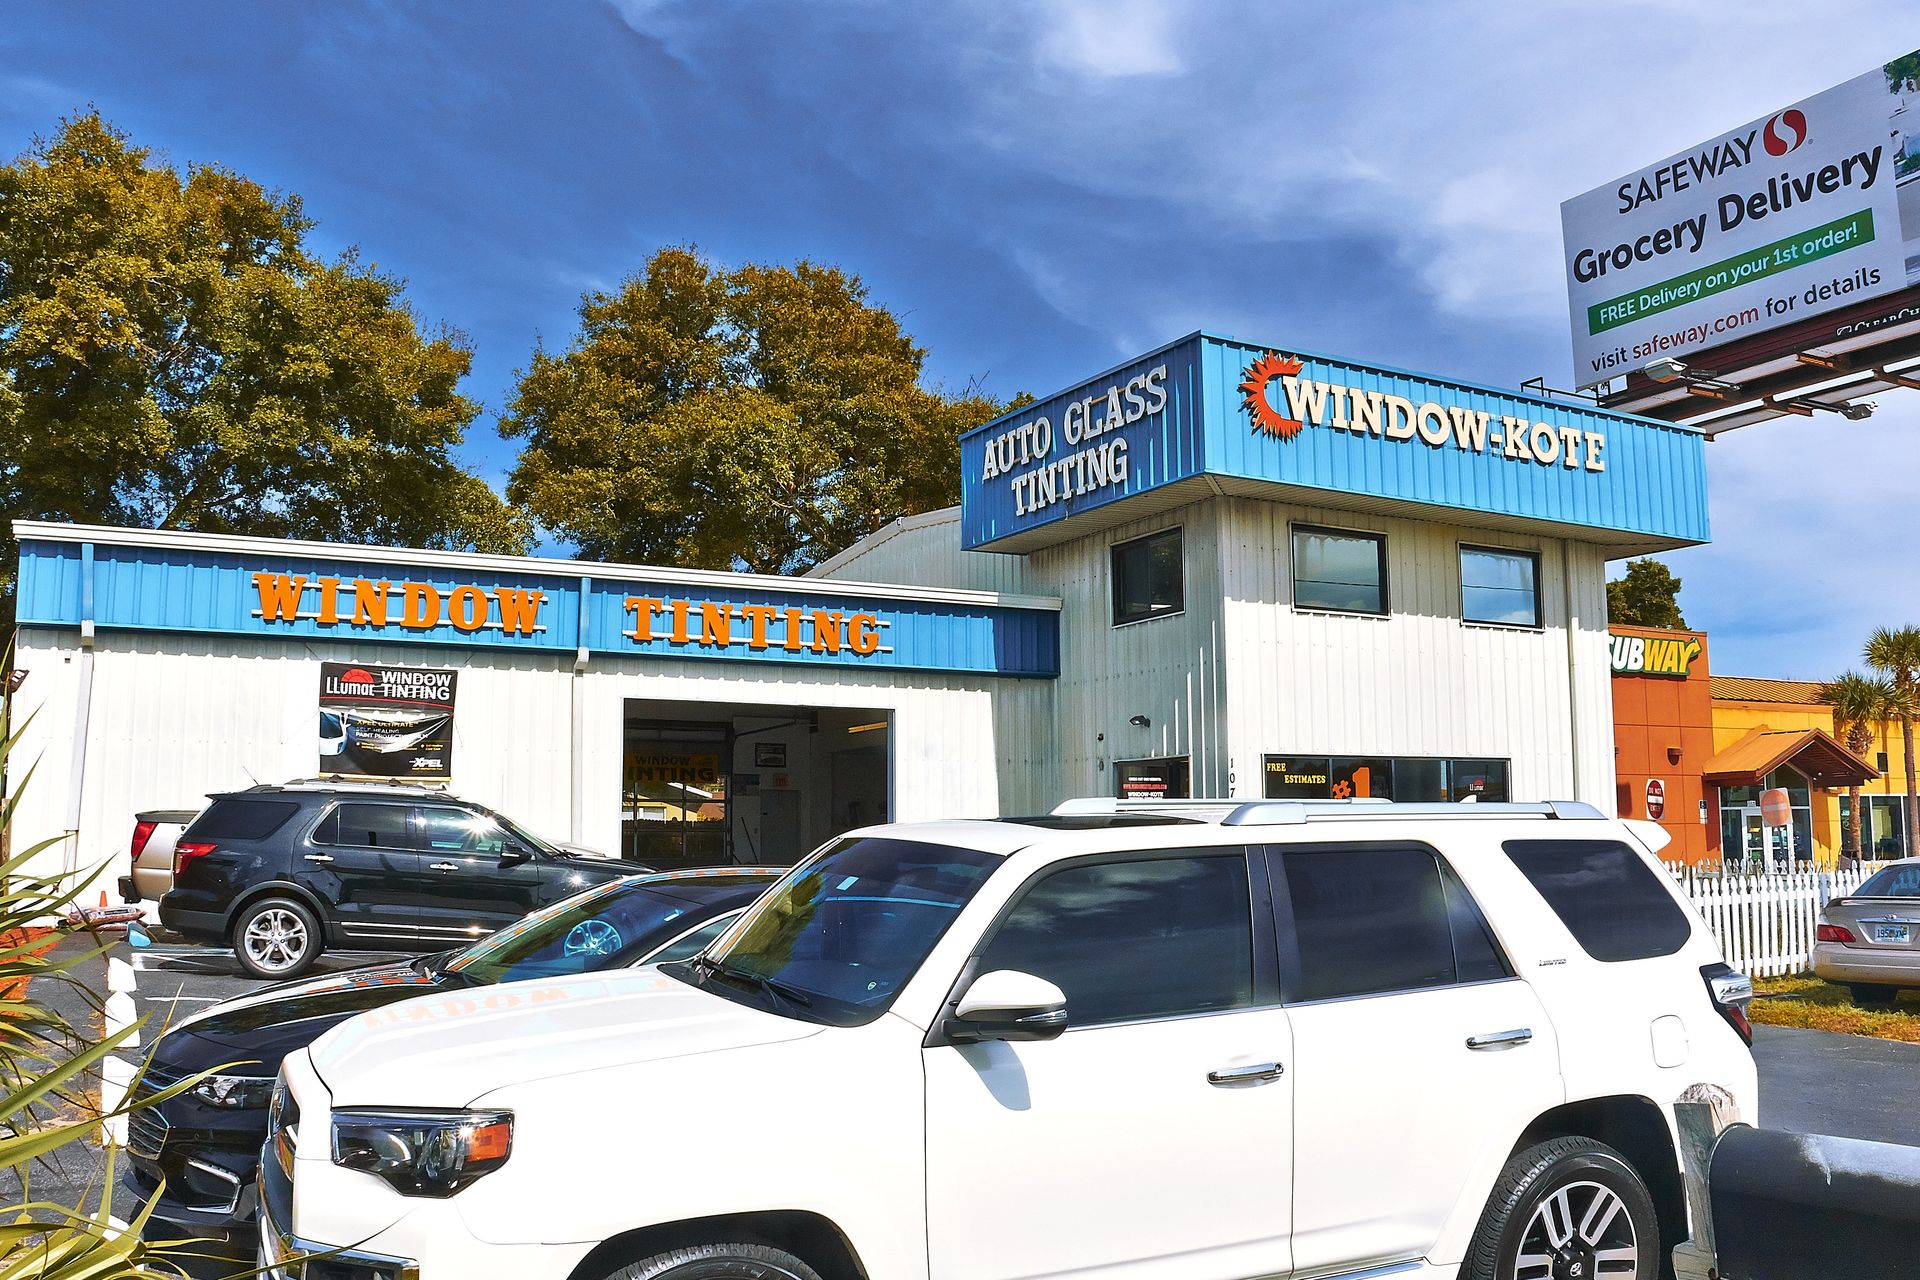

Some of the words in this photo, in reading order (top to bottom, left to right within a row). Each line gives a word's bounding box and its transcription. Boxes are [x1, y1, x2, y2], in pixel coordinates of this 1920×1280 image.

[1618, 129, 1758, 214] SAFEWAY
[1573, 213, 1707, 284] Grocery
[1717, 145, 1883, 232] Delivery
[1600, 299, 1636, 325] FREE
[1639, 279, 1702, 311] Delivery
[1705, 271, 1727, 289] on
[1730, 256, 1770, 285] your
[1773, 244, 1799, 266] 1st
[1802, 221, 1858, 255] order!
[1591, 347, 1628, 372] visit
[1633, 307, 1760, 359] safeway.com
[1765, 294, 1797, 318] for
[1803, 267, 1881, 305] details
[982, 416, 1052, 482] AUTO
[1063, 364, 1168, 445] GLASS
[1282, 375, 1606, 471] WINDOW-KOTE
[1011, 437, 1129, 517] TINTING
[252, 572, 544, 634] WINDOW
[625, 596, 879, 654] TINTING
[381, 670, 452, 687] WINDOW
[381, 683, 451, 701] TINTING
[625, 767, 714, 782] INTING
[1266, 762, 1286, 772] FREE
[1284, 774, 1326, 784] ESTIMATES
